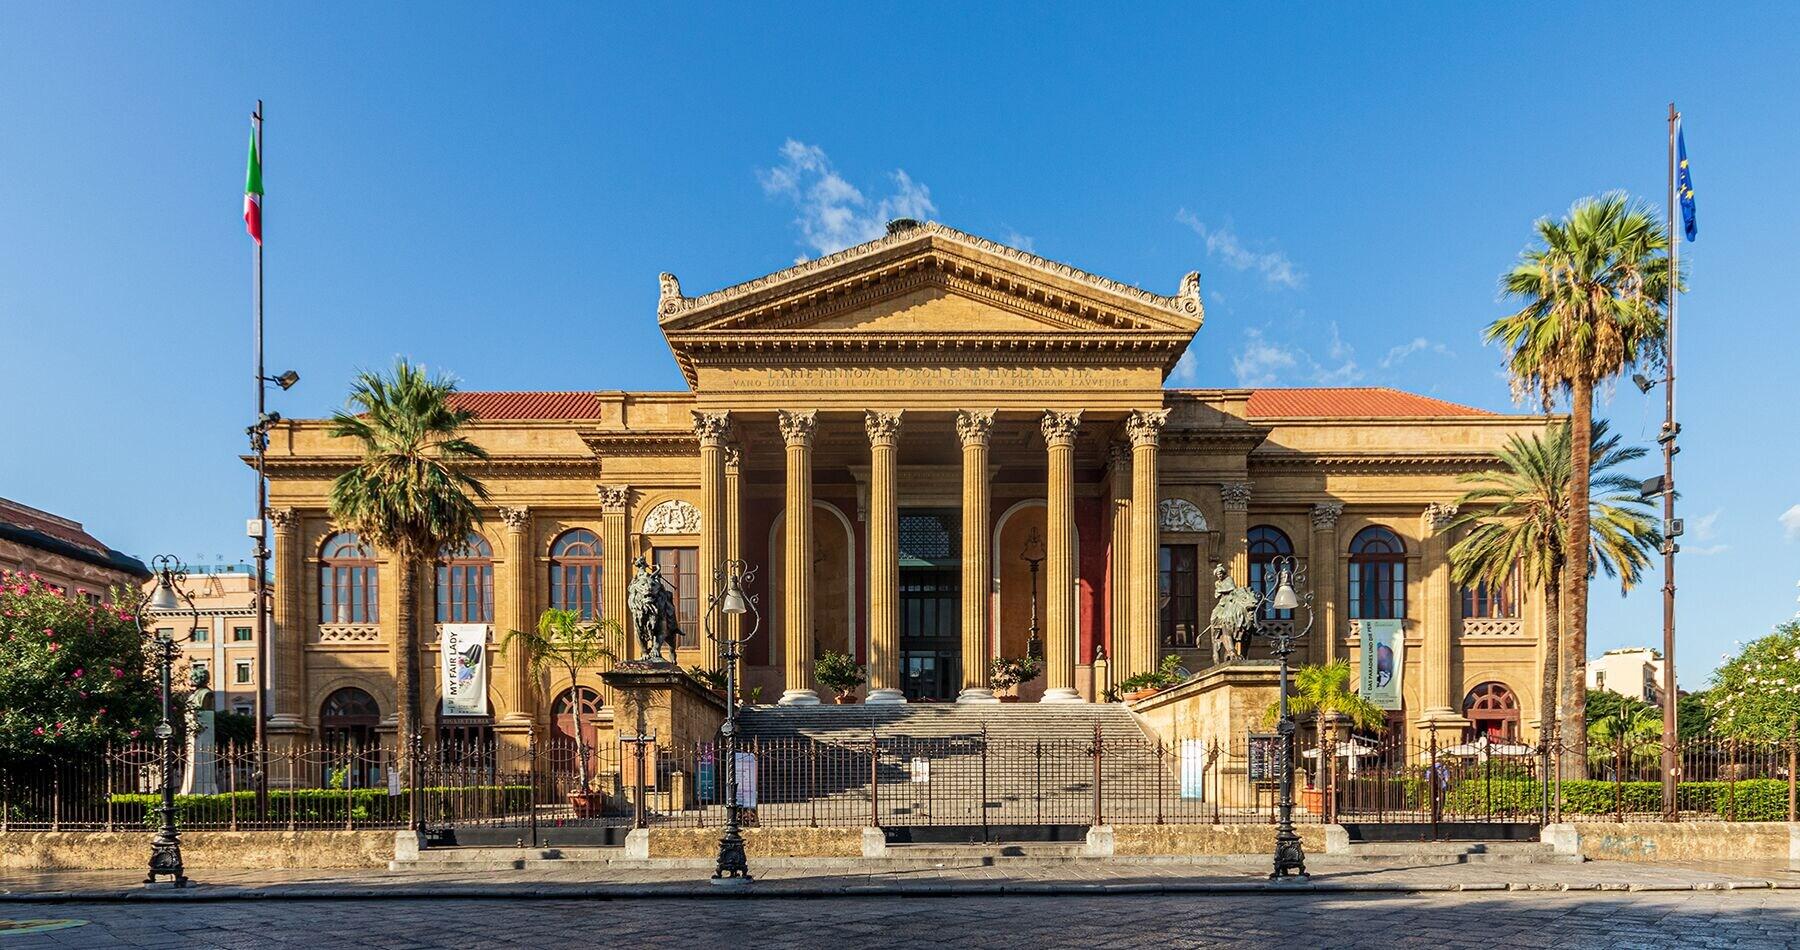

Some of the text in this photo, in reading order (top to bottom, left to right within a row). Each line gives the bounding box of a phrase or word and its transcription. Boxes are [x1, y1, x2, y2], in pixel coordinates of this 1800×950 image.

[769, 369, 813, 378] LARTE
[820, 369, 880, 378] RINNOVA
[898, 369, 942, 378] POPOLI
[988, 369, 1033, 378] RIVELA
[1042, 369, 1056, 378] LA
[1064, 369, 1092, 378] VITA
[450, 632, 458, 656] LADY
[450, 680, 457, 696] MY
